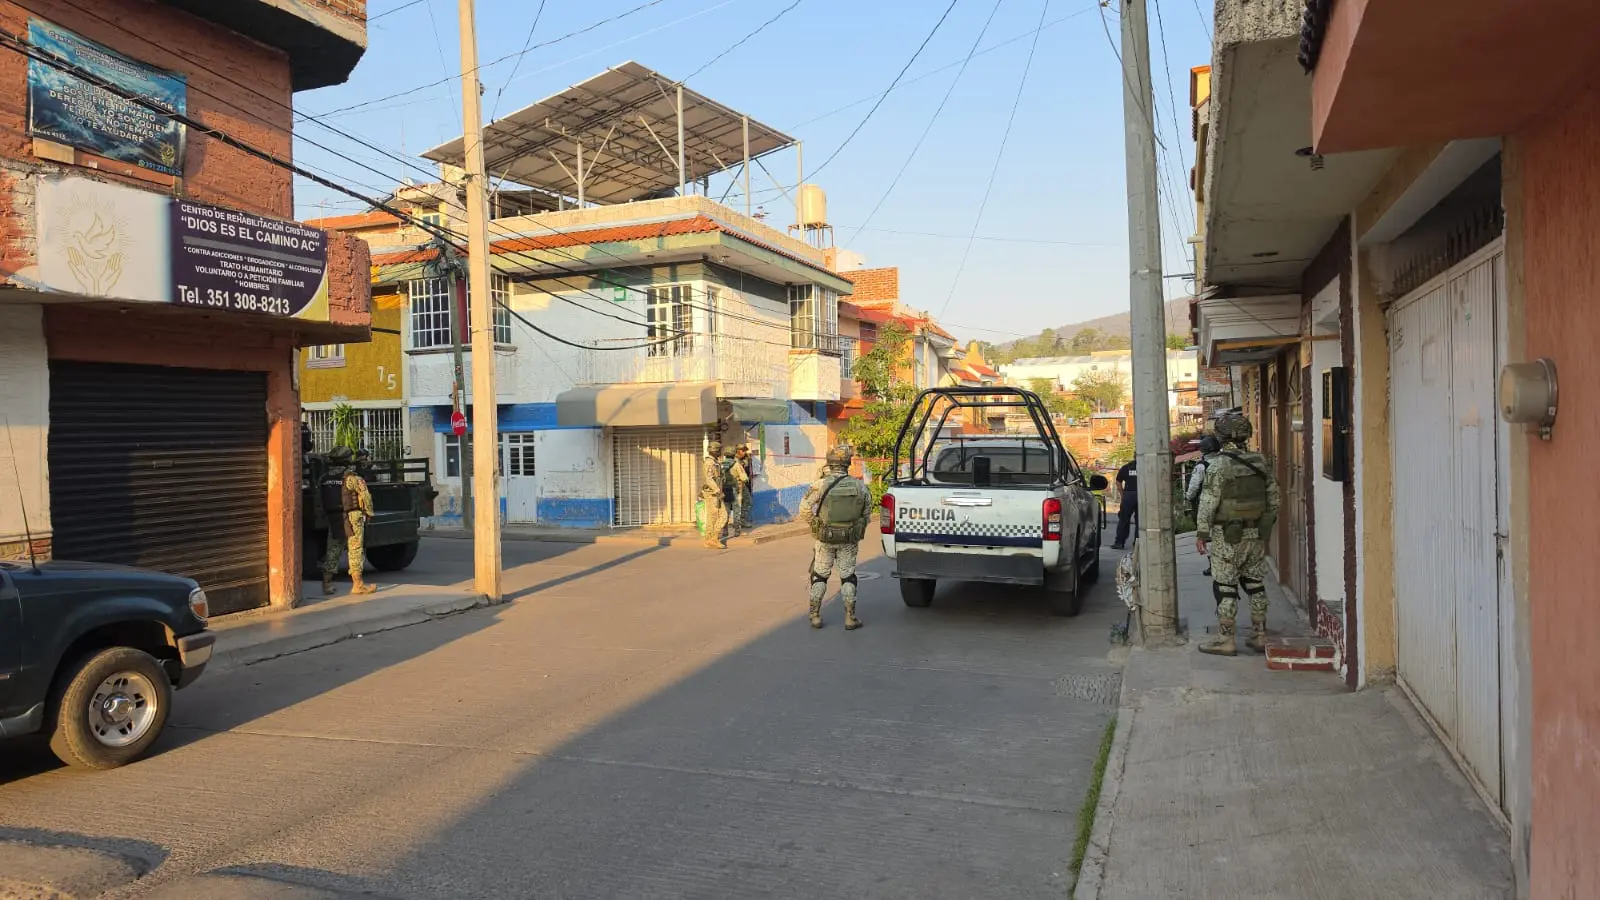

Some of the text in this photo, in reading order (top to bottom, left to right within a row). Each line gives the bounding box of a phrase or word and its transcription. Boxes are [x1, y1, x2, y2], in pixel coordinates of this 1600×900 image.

[102, 107, 115, 118] YO
[129, 108, 156, 122] MANO
[181, 204, 214, 218] CENTRO
[214, 210, 226, 220] DE
[285, 225, 320, 239] CRISTIANO
[220, 223, 236, 237] ES
[239, 226, 254, 240] EL
[255, 230, 299, 249] CAMINO
[187, 247, 211, 256] CONTRA
[220, 260, 283, 277] TRATO HUMANITARIO
[195, 265, 237, 278] VOLUNTARIO
[249, 272, 278, 284] PETICIÓN
[278, 278, 305, 289] FAMILIAR
[239, 280, 270, 291] HOMBRES
[177, 285, 290, 314] Tel. 351 308-8213
[899, 507, 956, 521] POLICIA
